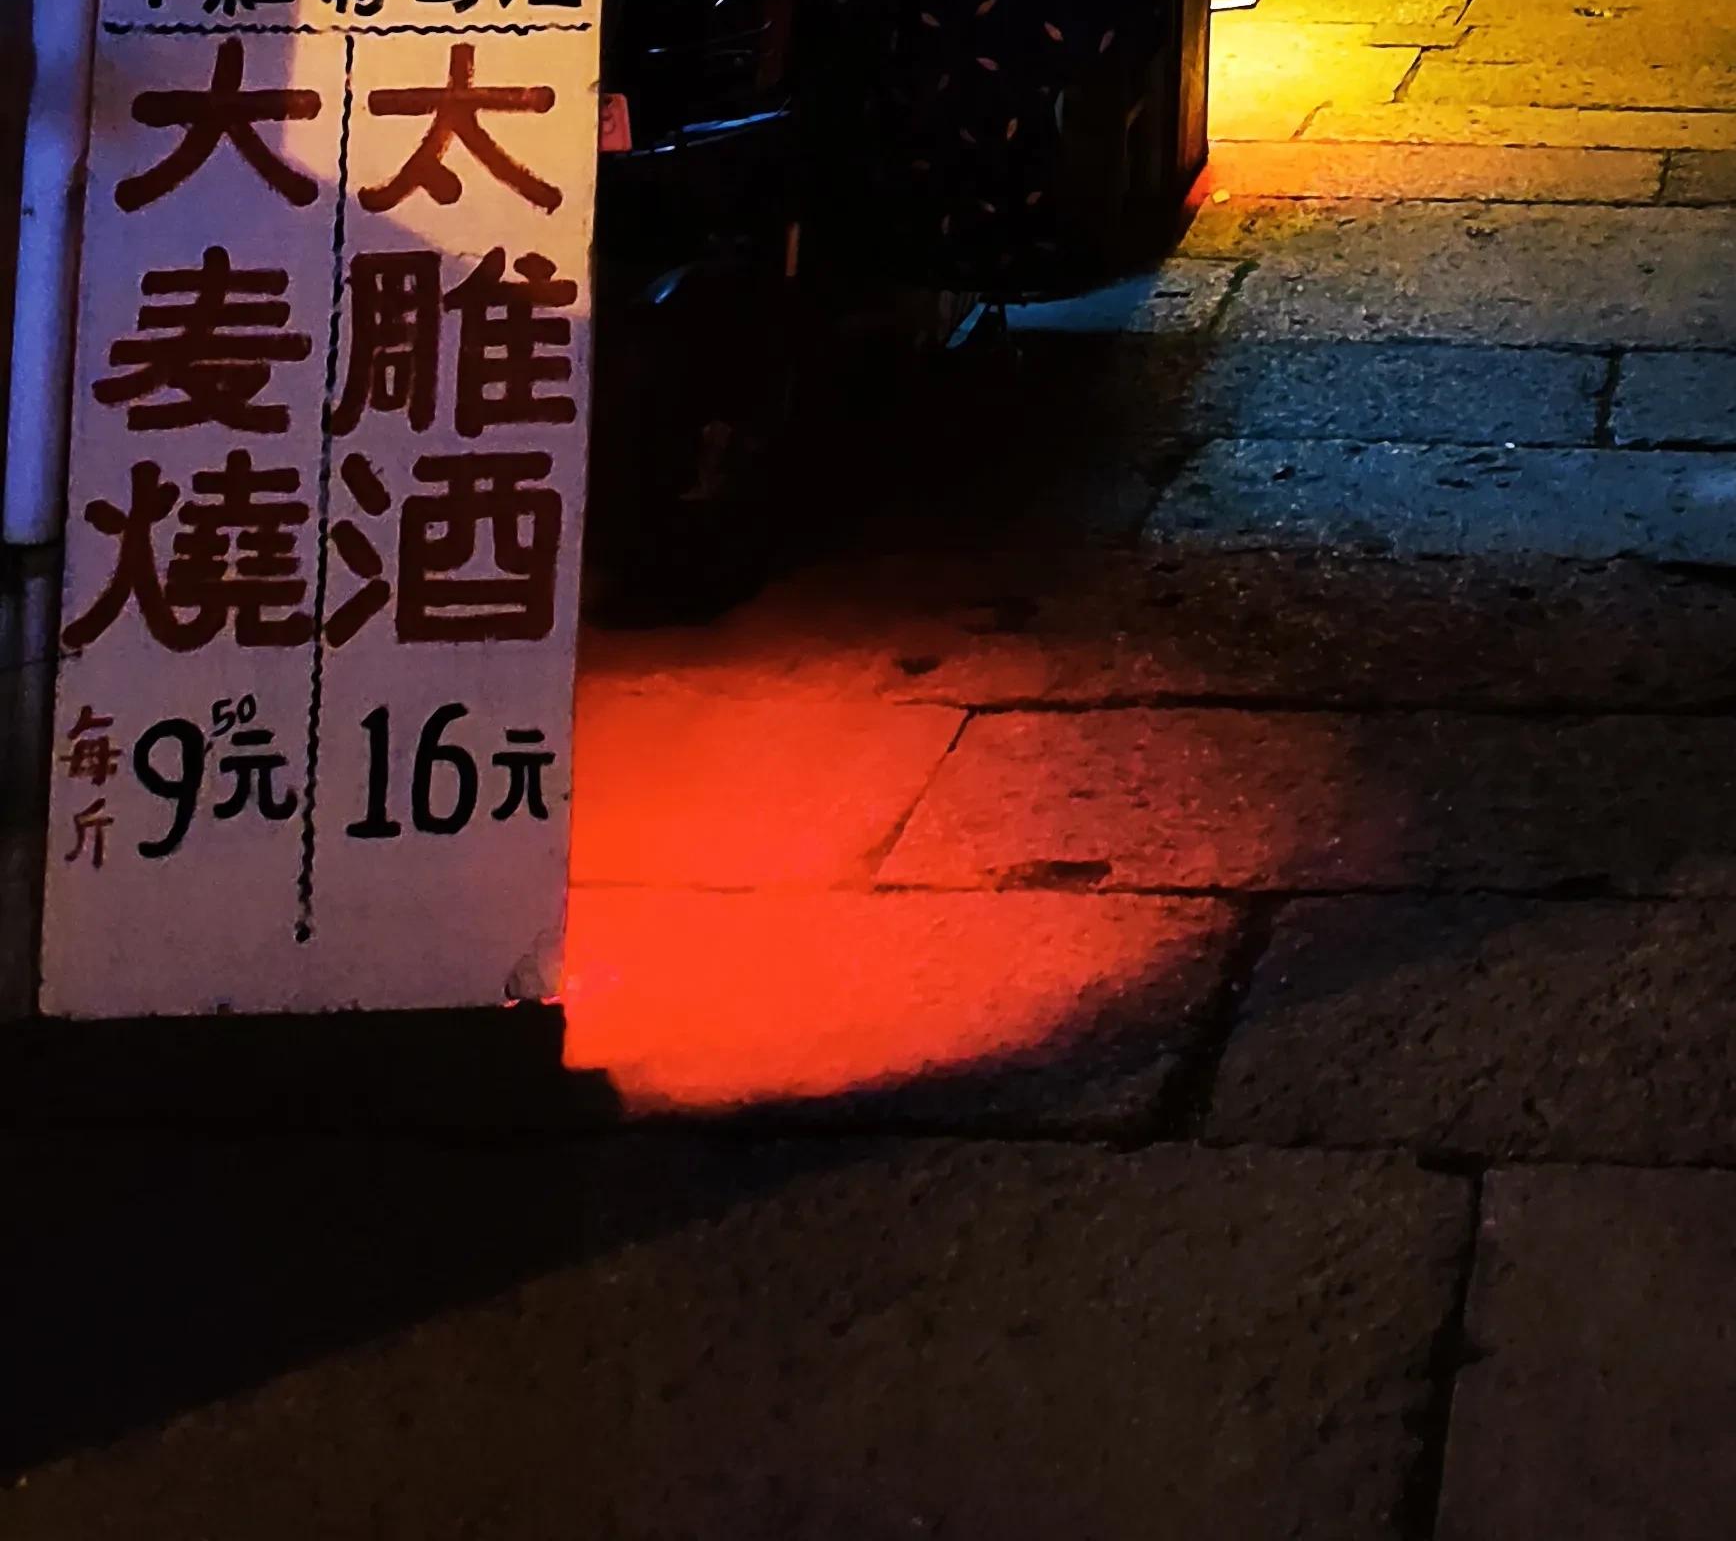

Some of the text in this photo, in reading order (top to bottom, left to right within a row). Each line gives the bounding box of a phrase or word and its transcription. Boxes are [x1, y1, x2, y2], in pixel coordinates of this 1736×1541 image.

[326, 41, 580, 649] 太雕酒
[59, 705, 123, 869] 每斤
[346, 702, 557, 838] 16元
